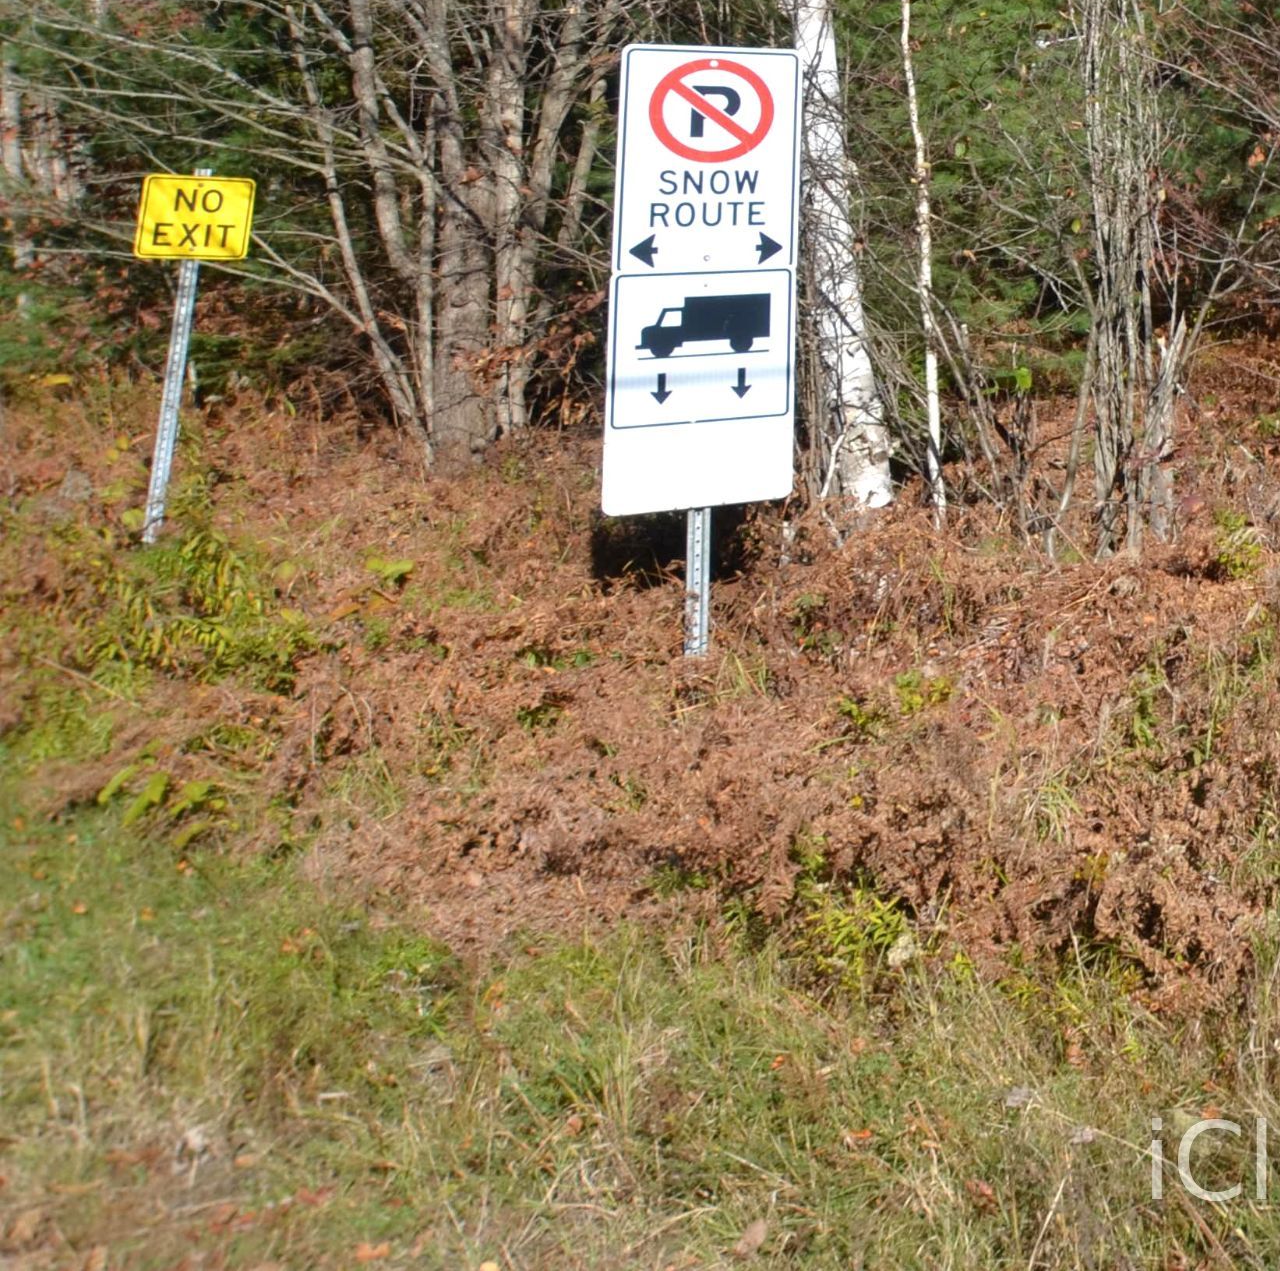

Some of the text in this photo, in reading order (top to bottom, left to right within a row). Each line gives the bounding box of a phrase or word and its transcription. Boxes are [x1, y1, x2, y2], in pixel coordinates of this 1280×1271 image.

[689, 85, 741, 138] P
[658, 170, 759, 195] SNOW
[174, 188, 224, 213] NO
[649, 201, 766, 228] ROUTE
[152, 222, 236, 248] EXIT
